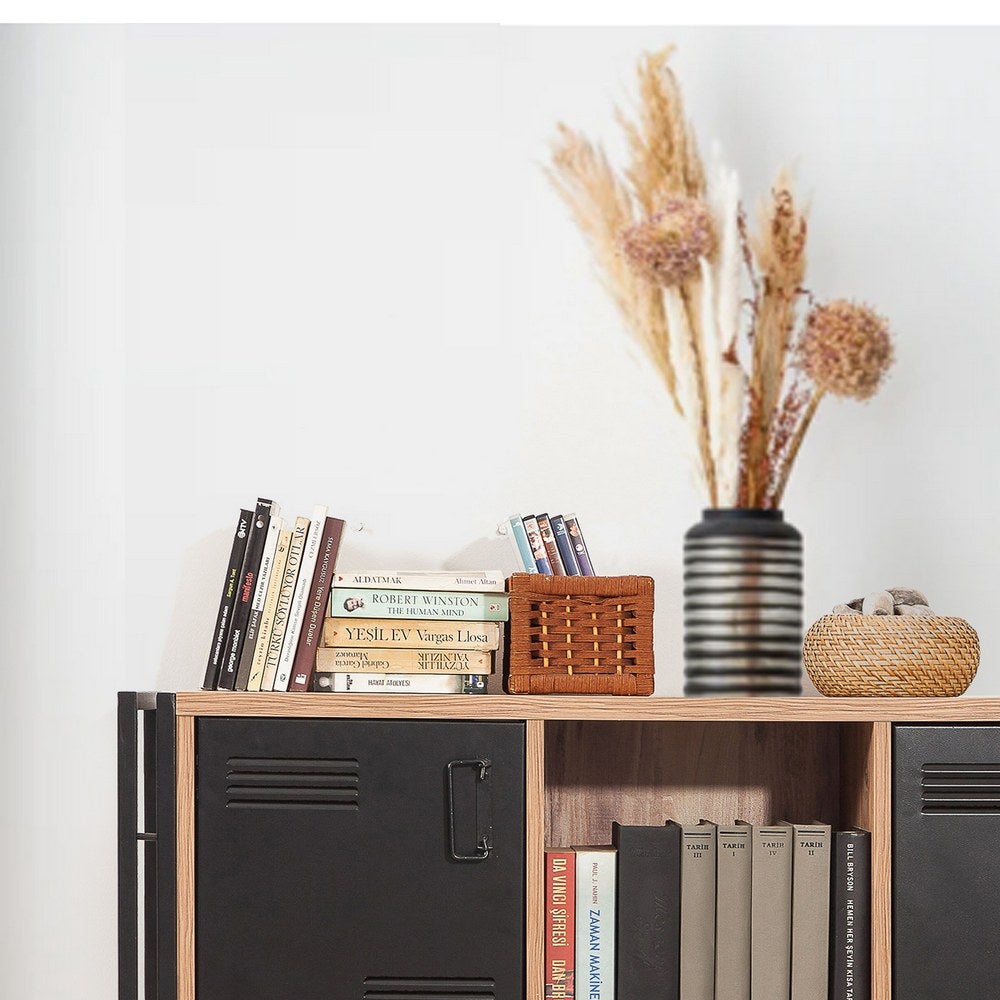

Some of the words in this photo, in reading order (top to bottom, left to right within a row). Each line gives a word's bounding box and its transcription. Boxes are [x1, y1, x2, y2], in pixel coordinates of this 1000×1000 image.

[242, 572, 254, 602] manifesto
[372, 594, 418, 605] ROBERT
[423, 596, 479, 607] WINSTON
[345, 626, 388, 641] YEŞİL
[391, 628, 411, 641] EV
[417, 629, 454, 645] Vargas
[457, 630, 488, 642] Llosa
[266, 627, 282, 668] TÜRKÜ
[552, 858, 566, 872] DA
[552, 875, 566, 904] VINCI
[550, 908, 568, 946] ŞİFRESİ
[589, 909, 600, 950] ZAMAN
[845, 945, 853, 967] ŞEYİN
[552, 960, 565, 980] DAN
